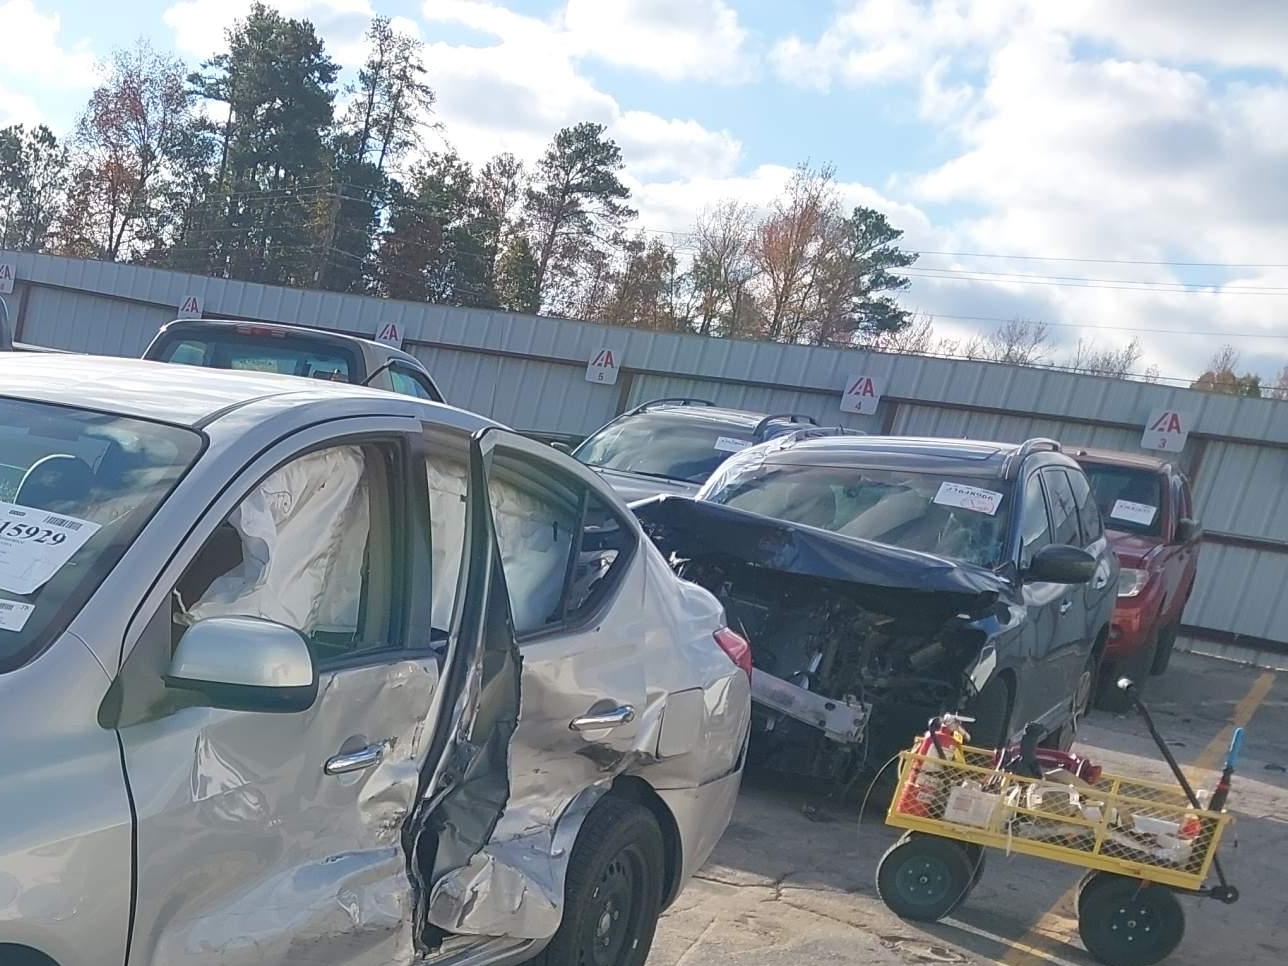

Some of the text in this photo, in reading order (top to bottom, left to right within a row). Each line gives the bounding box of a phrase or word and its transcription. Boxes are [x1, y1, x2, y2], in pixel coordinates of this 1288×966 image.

[598, 372, 604, 381] 5
[855, 401, 862, 410] 4
[1158, 438, 1167, 449] 3
